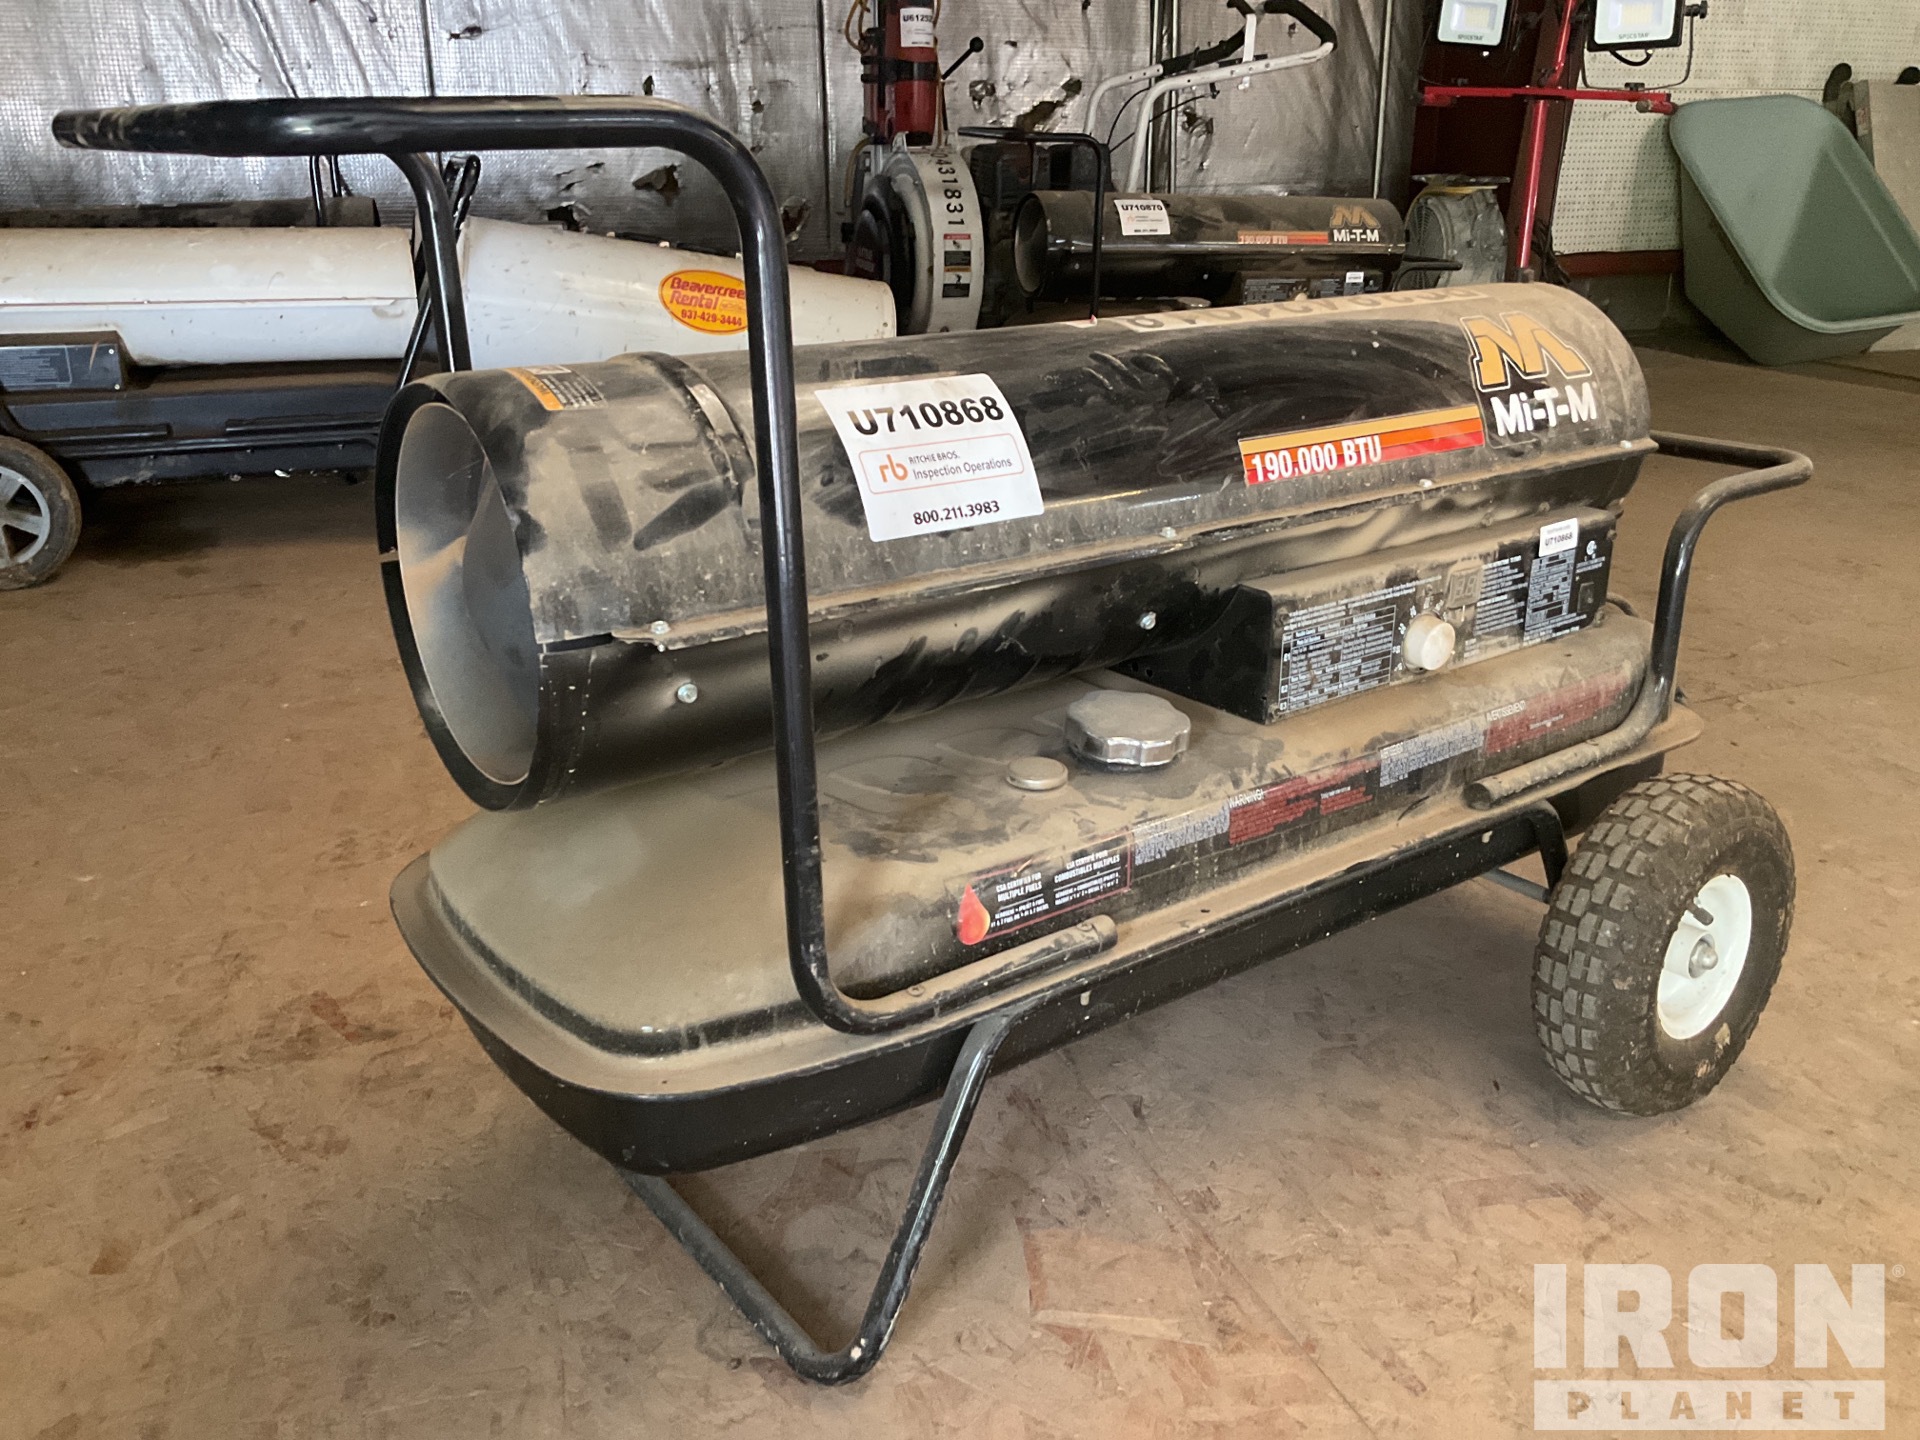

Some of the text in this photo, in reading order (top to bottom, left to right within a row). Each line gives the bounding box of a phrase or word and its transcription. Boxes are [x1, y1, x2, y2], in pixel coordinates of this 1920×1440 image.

[1333, 229, 1380, 242] Mi-T-M
[670, 277, 746, 299] Beavercree
[670, 290, 719, 310] Rental
[847, 396, 1004, 435] U710868
[1490, 382, 1597, 437] Mi-T-M
[909, 451, 961, 464] RITCHIE BROS.
[912, 457, 1012, 481] Inspection Operations
[1251, 435, 1382, 483] 190,000 BTU
[913, 500, 1000, 525] 800.211.3983
[1228, 789, 1265, 809] WARNING!
